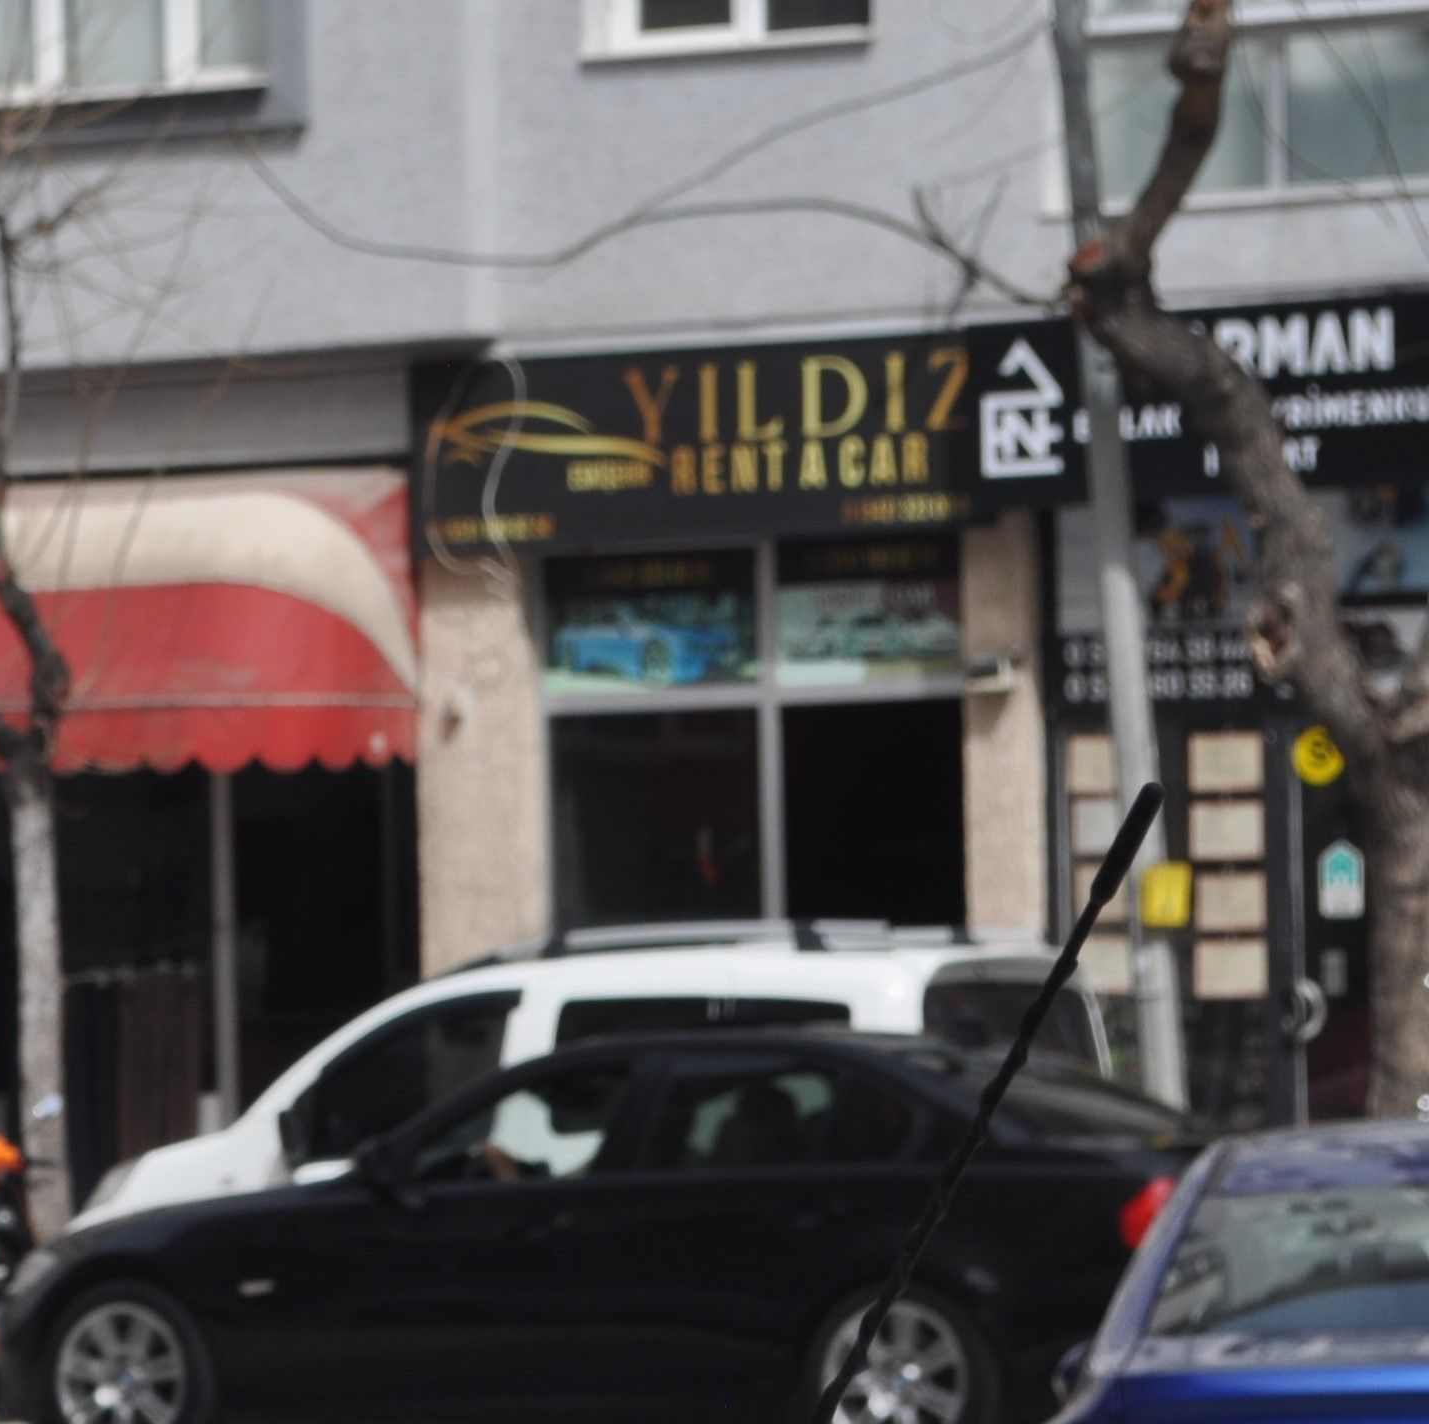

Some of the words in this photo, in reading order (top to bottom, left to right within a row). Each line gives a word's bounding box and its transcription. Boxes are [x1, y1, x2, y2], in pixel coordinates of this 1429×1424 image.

[672, 440, 786, 494] RENT
[798, 436, 829, 489] A
[838, 430, 929, 488] CAR
